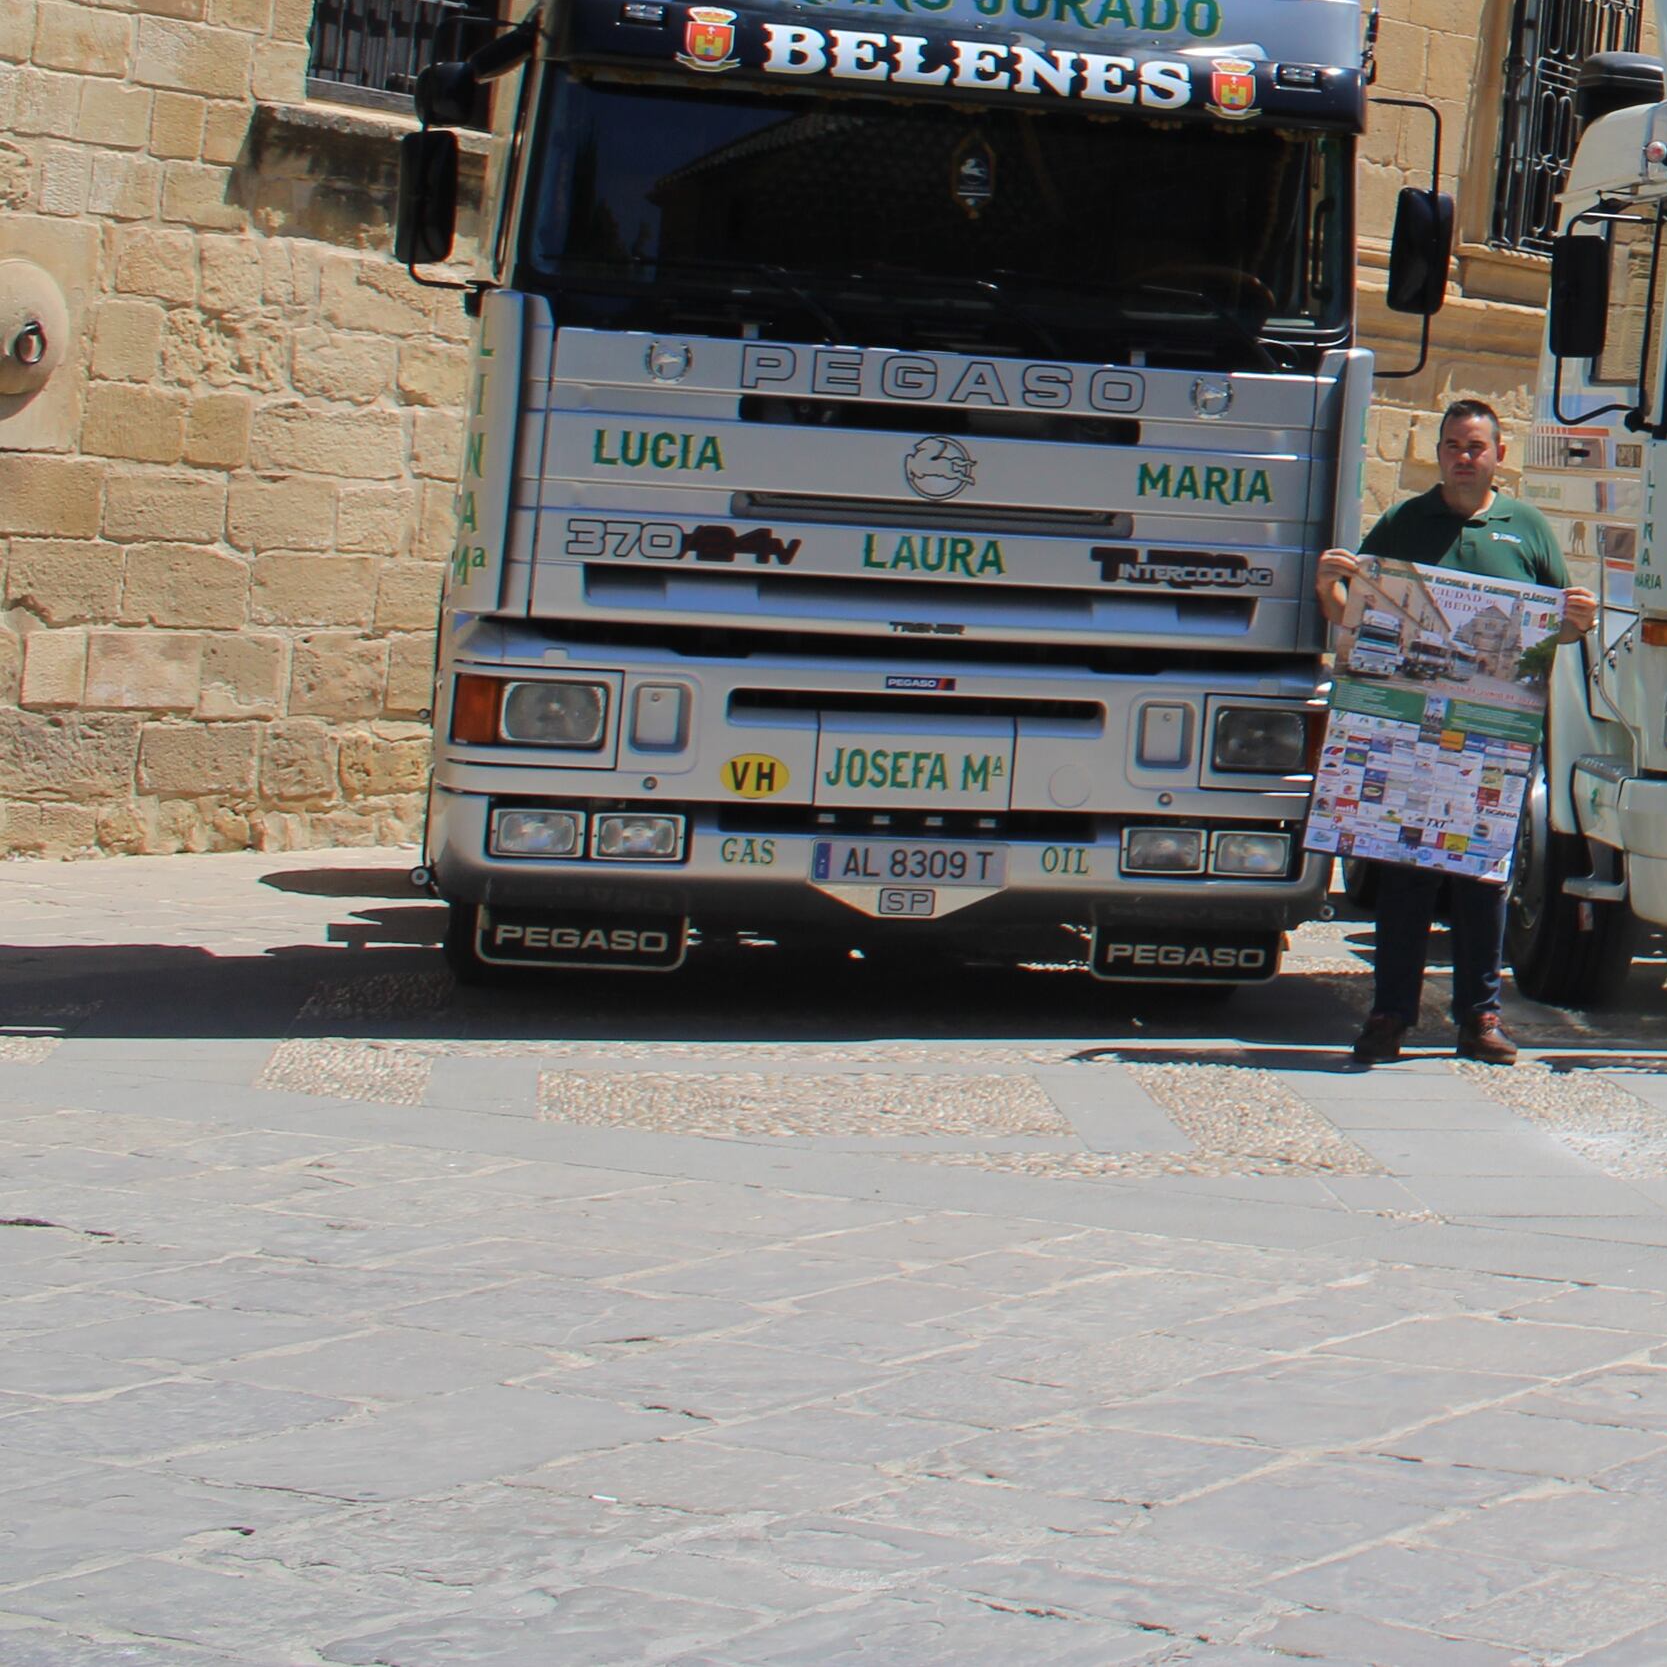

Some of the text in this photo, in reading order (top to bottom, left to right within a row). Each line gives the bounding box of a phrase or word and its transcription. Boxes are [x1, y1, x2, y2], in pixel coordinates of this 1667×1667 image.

[762, 23, 1193, 111] BELENES
[741, 343, 1146, 414] PEGASO
[592, 428, 726, 473] LUCIA
[1136, 461, 1274, 506] MARIA
[861, 532, 1007, 579] LAURA
[1117, 561, 1274, 587] INTERCOOLING
[886, 677, 938, 690] PEGASO
[730, 760, 779, 793] VH
[824, 746, 950, 792] JOSEFA
[720, 837, 777, 866] GAS
[842, 846, 995, 881] AL 8309 T
[1041, 845, 1091, 875] OIL
[885, 891, 931, 914] SP
[494, 924, 670, 953] PEGASO
[1105, 943, 1267, 968] PEGASO
